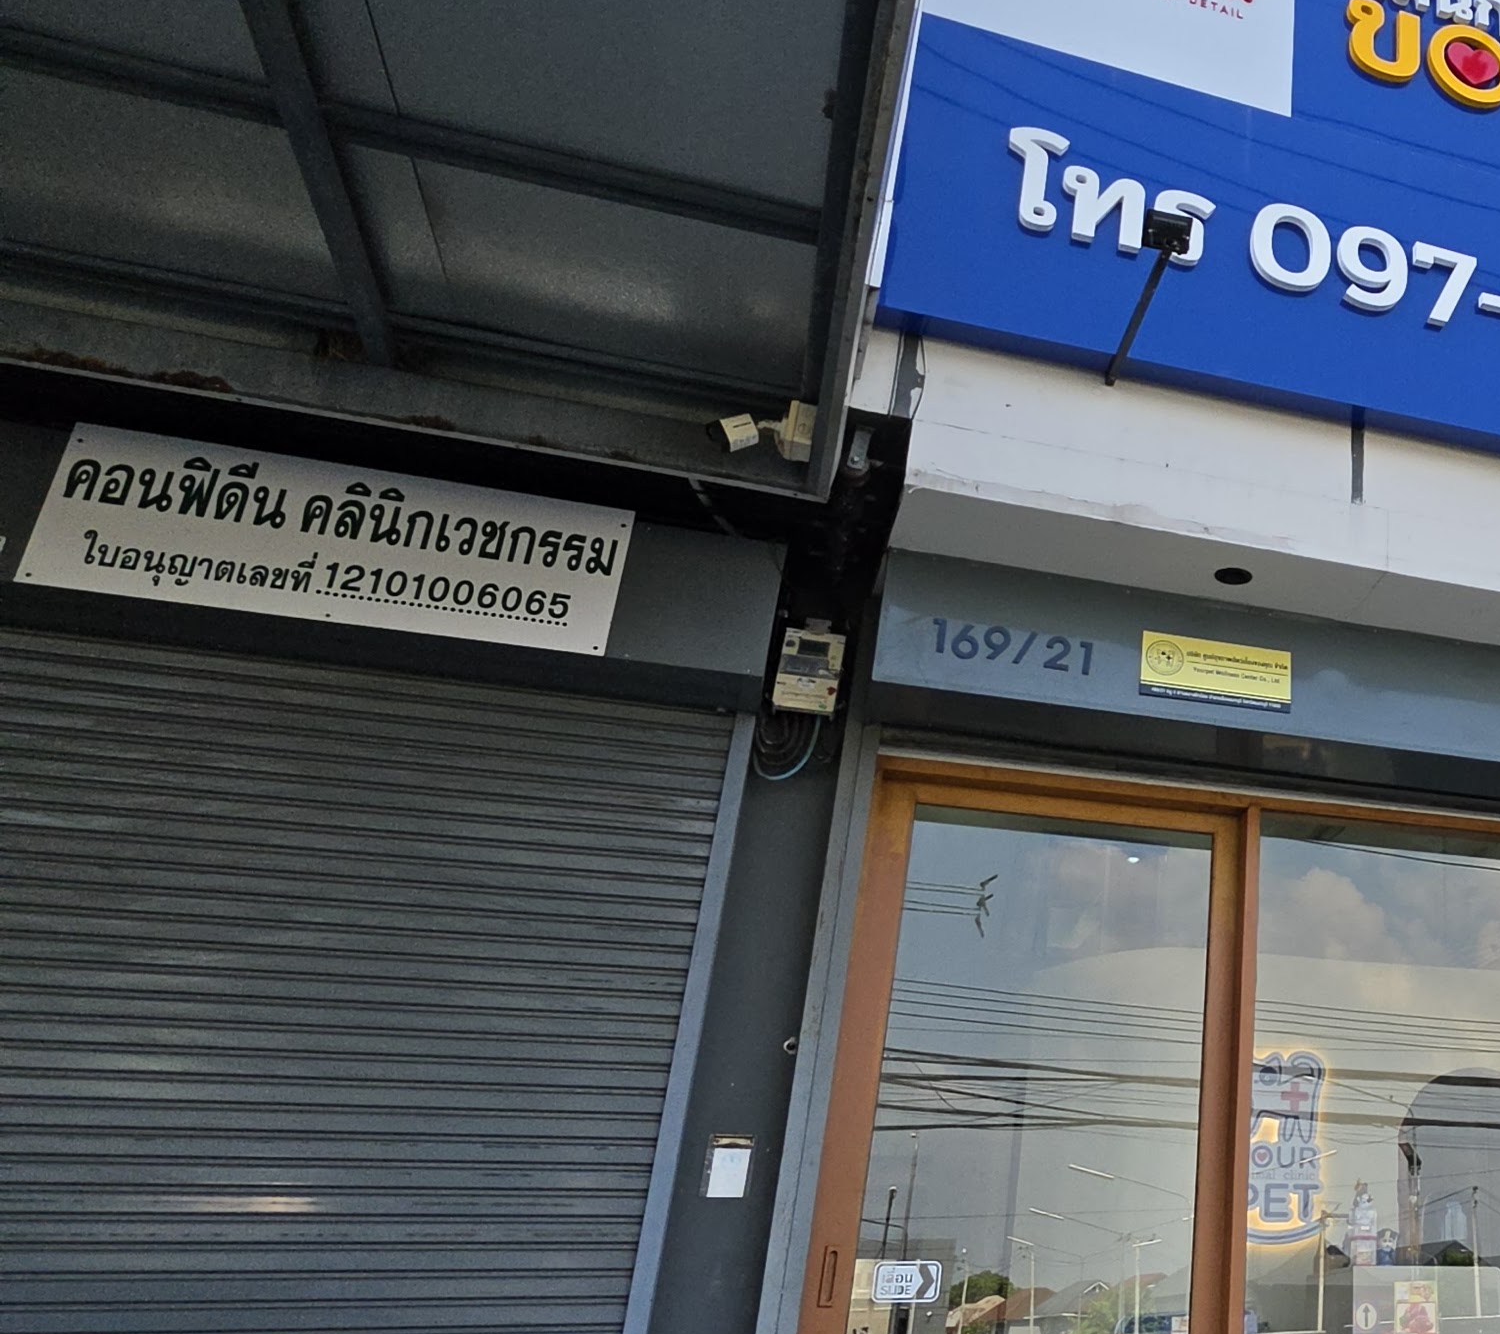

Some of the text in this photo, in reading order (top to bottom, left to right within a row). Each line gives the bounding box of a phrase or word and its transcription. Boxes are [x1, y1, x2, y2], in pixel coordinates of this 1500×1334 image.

[1009, 126, 1217, 267] โทร
[63, 456, 618, 576] คอนฟิดีน คลินิกเวชกรรม
[83, 530, 571, 619] ใบอนุญาตเลขที่ 12101006065
[933, 618, 1094, 676] 169/21
[1251, 1145, 1318, 1169] OUR
[880, 1285, 912, 1296] SLIDE
[882, 1267, 913, 1283] เลื่อน
